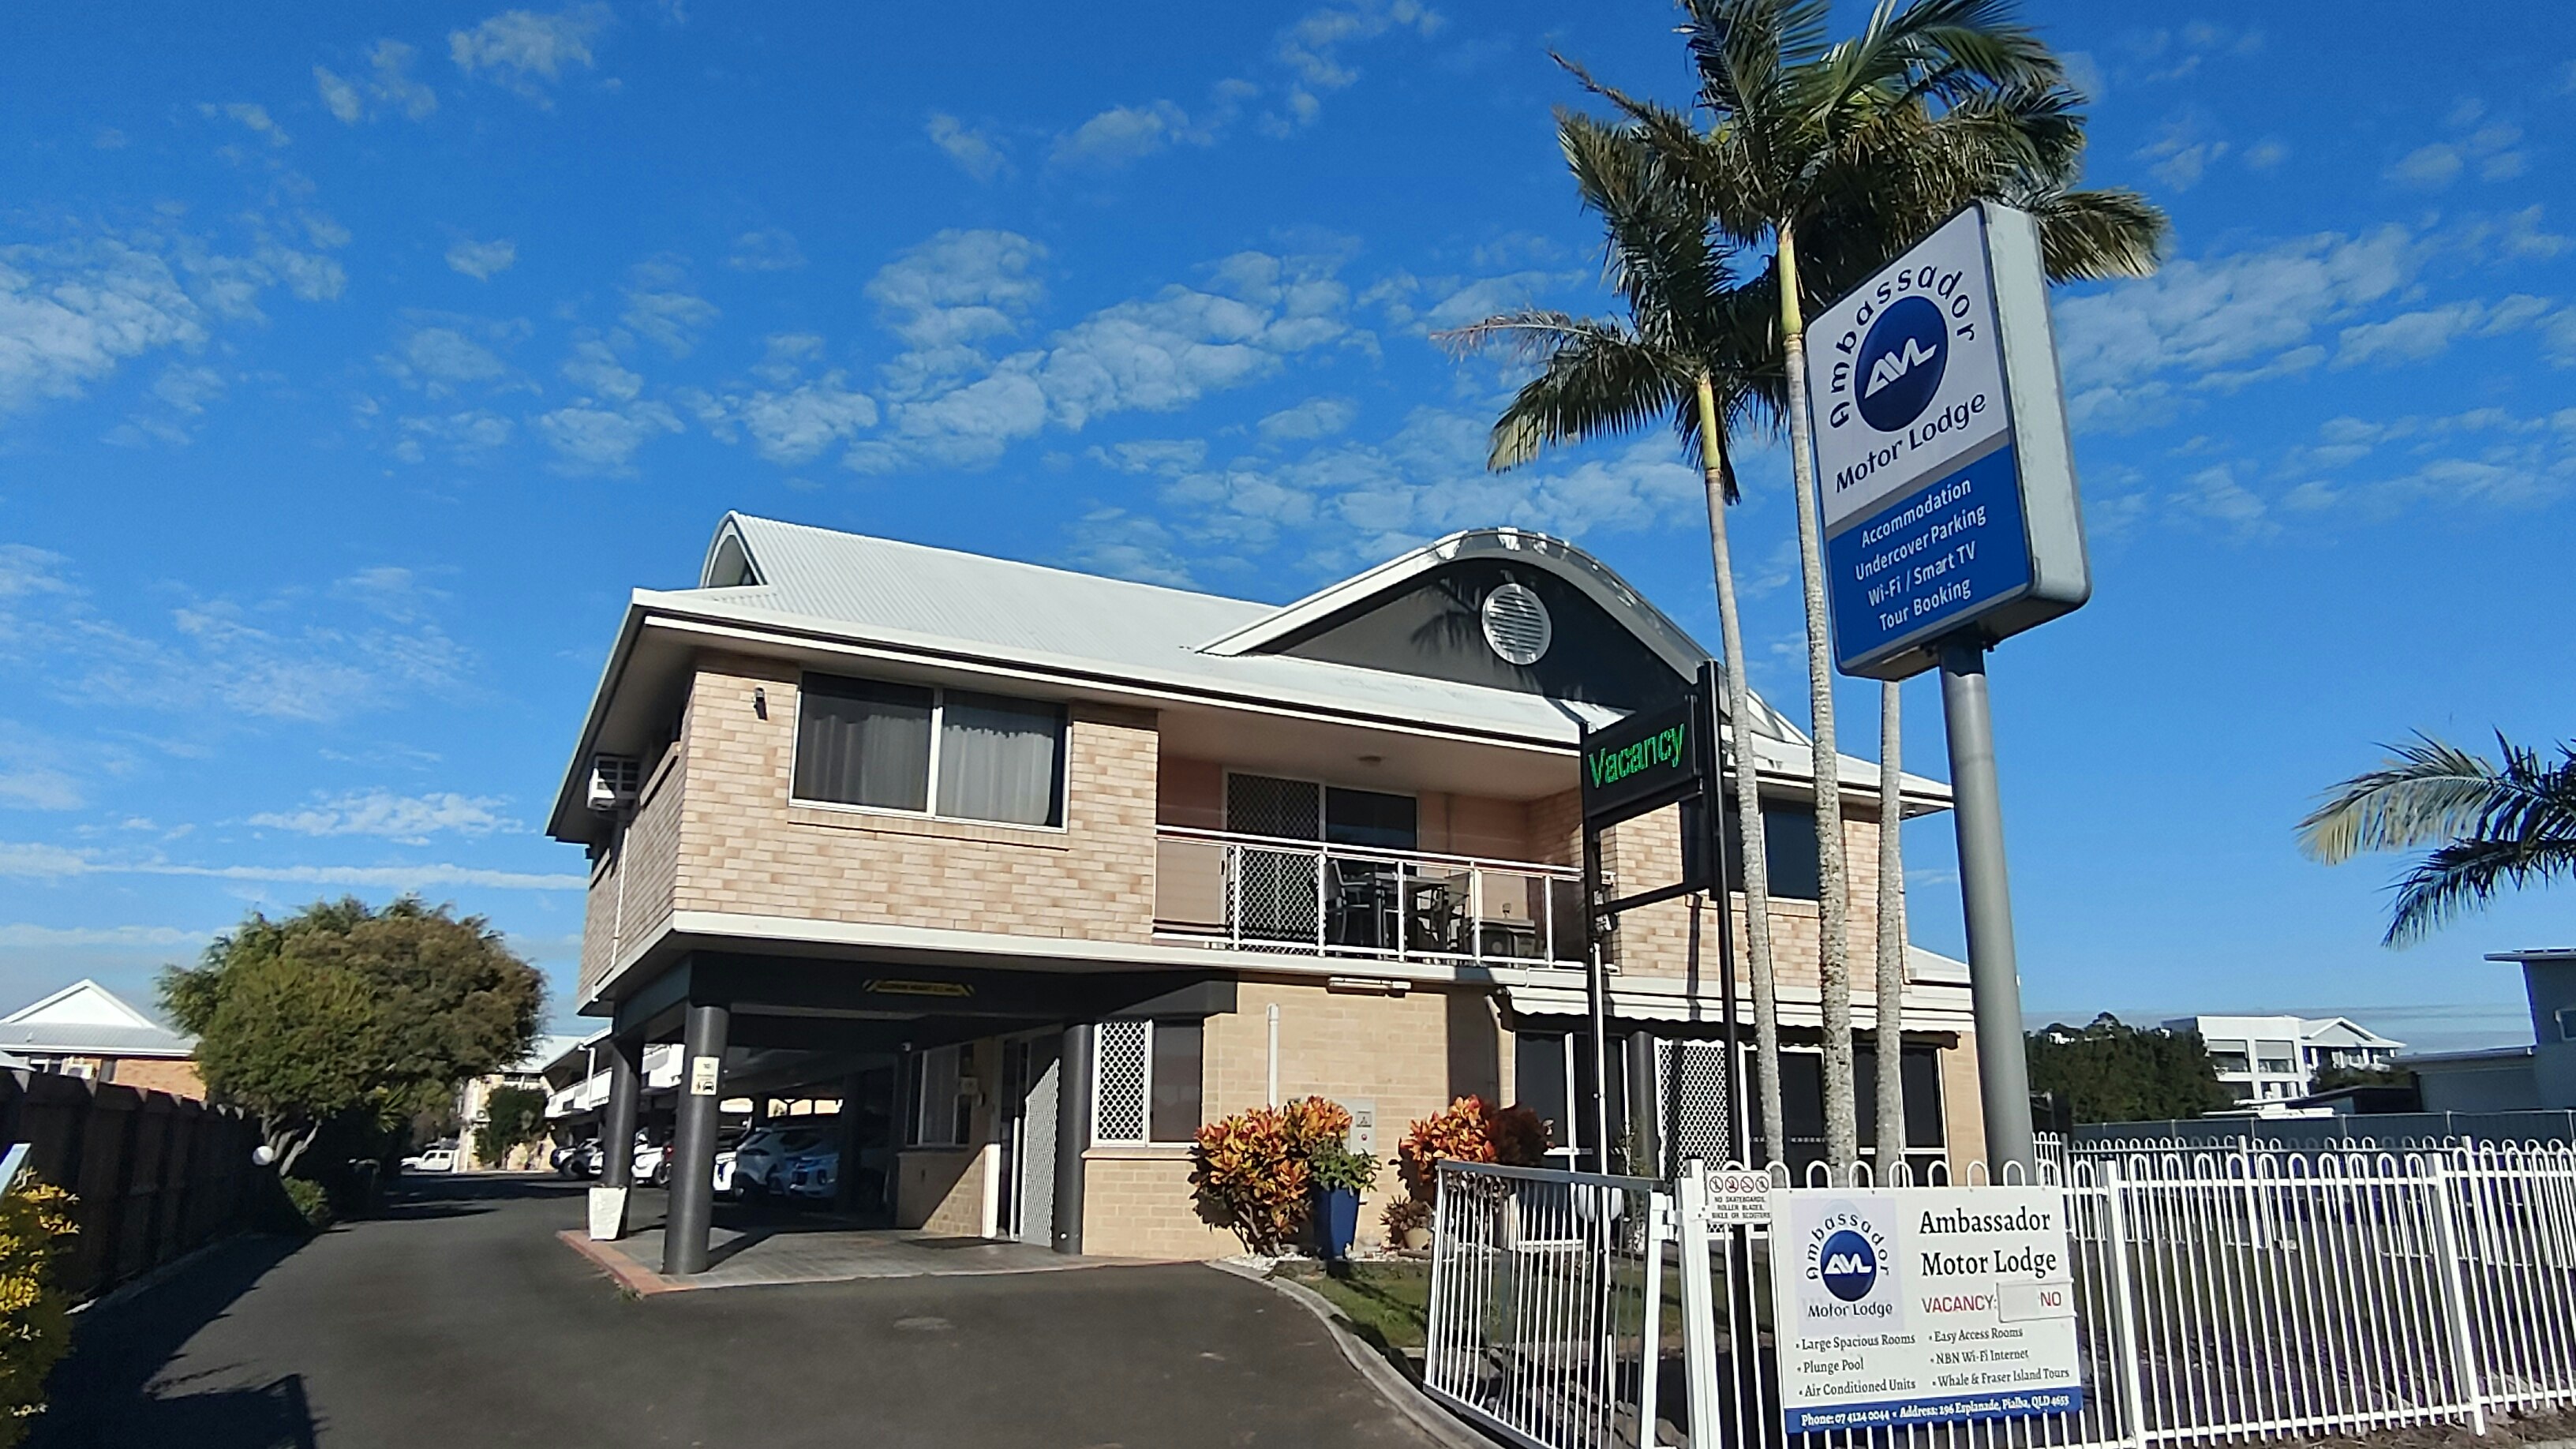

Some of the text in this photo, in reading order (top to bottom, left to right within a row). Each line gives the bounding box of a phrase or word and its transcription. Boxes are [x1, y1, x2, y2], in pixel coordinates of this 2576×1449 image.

[1837, 394, 1986, 492] Motor Lodge
[1862, 479, 1971, 549] Accommodation
[1855, 505, 1986, 581] Undercover Parking
[1868, 575, 1901, 607] Wi-Fi
[1914, 552, 1956, 585] Smart
[1956, 541, 1976, 564] TV
[1879, 578, 1971, 631] Tour Booking
[1588, 723, 1685, 788] Vacancy
[1919, 1205, 2050, 1234] Ambassador
[1921, 1246, 2057, 1279] Motor Lodge
[1808, 1302, 1893, 1318] Motor Lodge
[1922, 1291, 2061, 1313] VACANCY: NO
[1802, 1335, 1915, 1352] Large Spacious Rooms
[1934, 1327, 2023, 1344] Easy Access Rooms
[1803, 1357, 1864, 1375] Plunge Pool
[1936, 1348, 2029, 1365] NBN Wi-Fi Internet
[1804, 1379, 1915, 1397] Air Conditioned Units
[1937, 1368, 2069, 1387] Whale & Fraser Island Tours
[1801, 1413, 1834, 1426] Phone:
[1835, 1414, 1845, 1424] 07
[1847, 1412, 1867, 1423] 4124
[1868, 1410, 1890, 1421] 0044
[1899, 1405, 1939, 1417] Address:
[1955, 1399, 2001, 1416] Esplanade,
[2031, 1395, 2050, 1409] QLD
